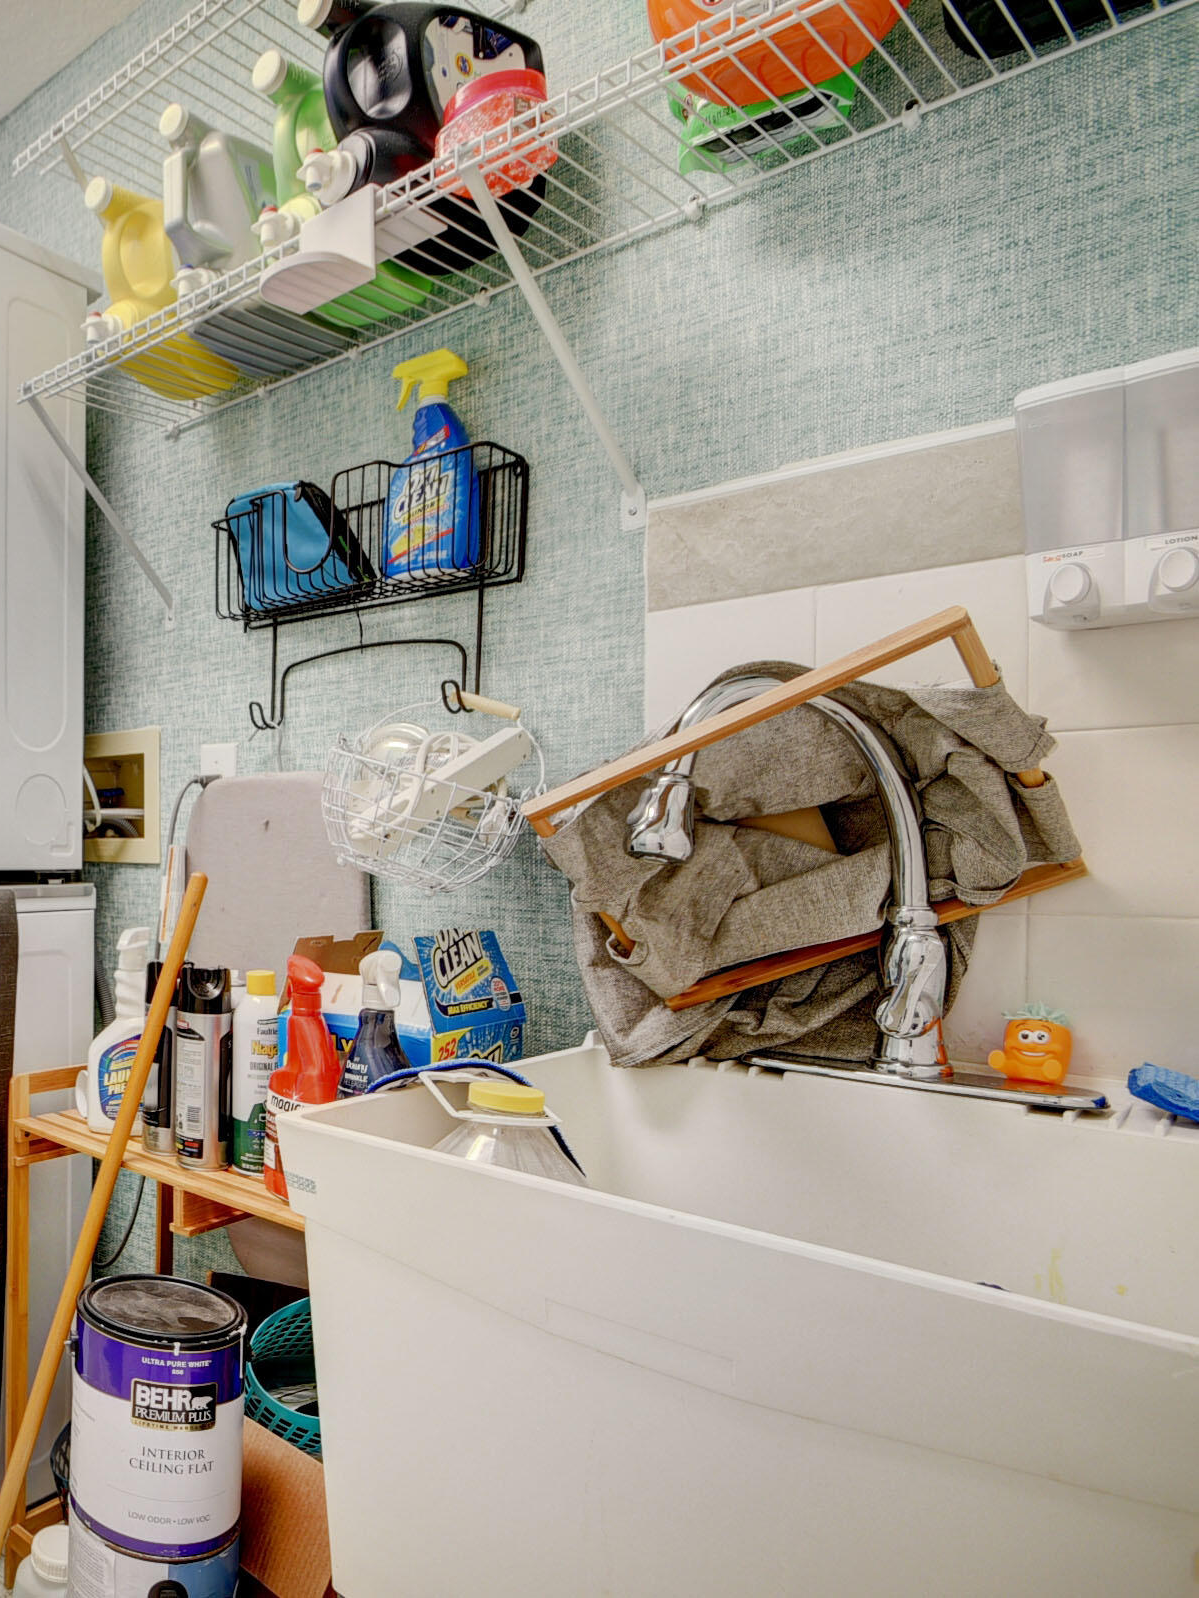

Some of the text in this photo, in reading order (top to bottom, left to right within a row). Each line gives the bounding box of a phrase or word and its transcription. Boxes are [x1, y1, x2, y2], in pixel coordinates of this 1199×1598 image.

[1164, 536, 1199, 545] LOTION
[1062, 551, 1084, 559] SOAP
[434, 930, 483, 989] CLEAN
[257, 1027, 278, 1036] Faultle
[252, 1040, 278, 1060] Niaga
[438, 1038, 457, 1061] 252
[142, 1356, 165, 1366] ULTRA
[167, 1360, 187, 1368] PURE
[135, 1383, 195, 1411] BEHR
[135, 1406, 212, 1423] PREMIUM PLUS
[142, 1446, 205, 1461] INTERIOR
[129, 1457, 215, 1475] CEILING FLAT
[128, 1511, 146, 1521] LOW
[147, 1515, 172, 1525] ODOR
[177, 1518, 195, 1526] LOW
